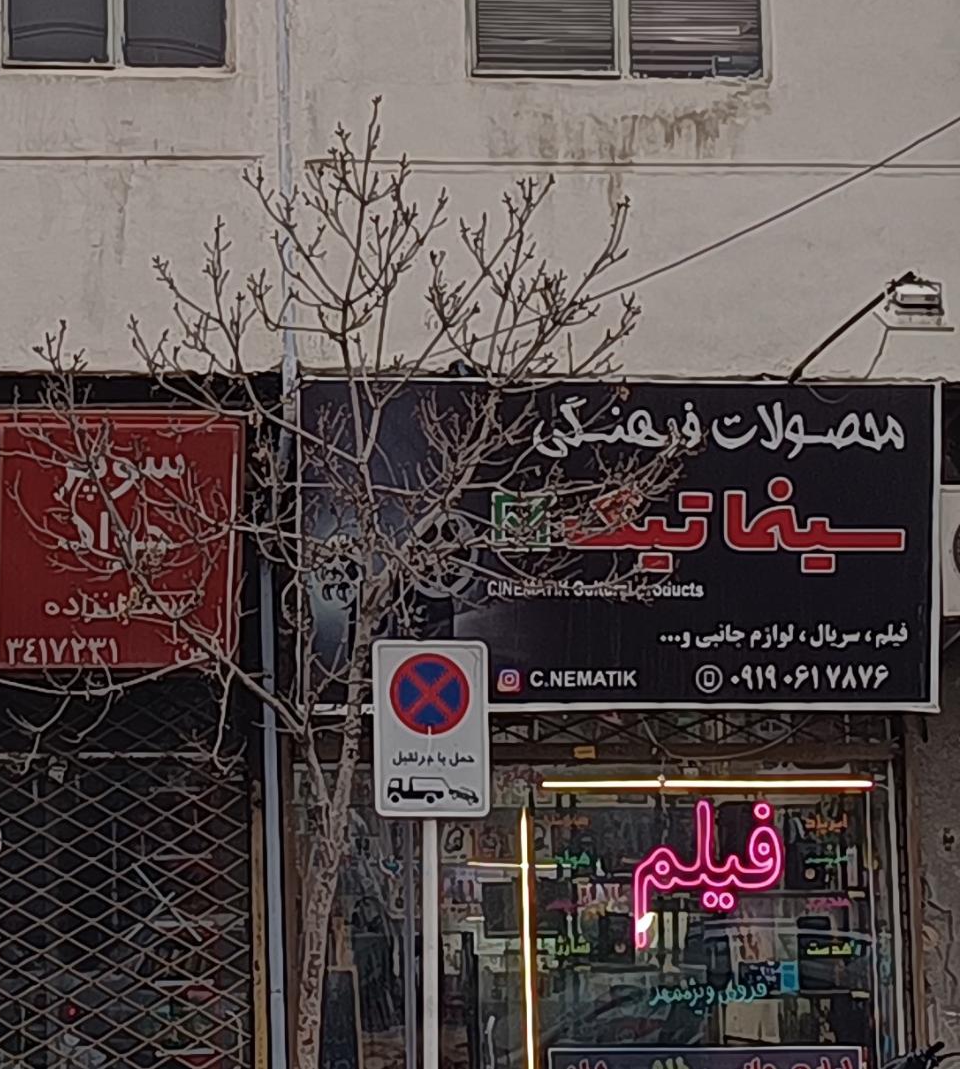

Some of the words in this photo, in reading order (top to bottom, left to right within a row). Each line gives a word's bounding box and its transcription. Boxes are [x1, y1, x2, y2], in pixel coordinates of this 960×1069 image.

[532, 395, 702, 457] فرهنگی
[711, 402, 906, 459] محصولات
[694, 622, 746, 649] جانبی
[749, 623, 795, 650] لوازم
[529, 669, 638, 689] C.NEMATIK
[448, 751, 476, 767] حمل
[634, 800, 785, 950] فیلم
